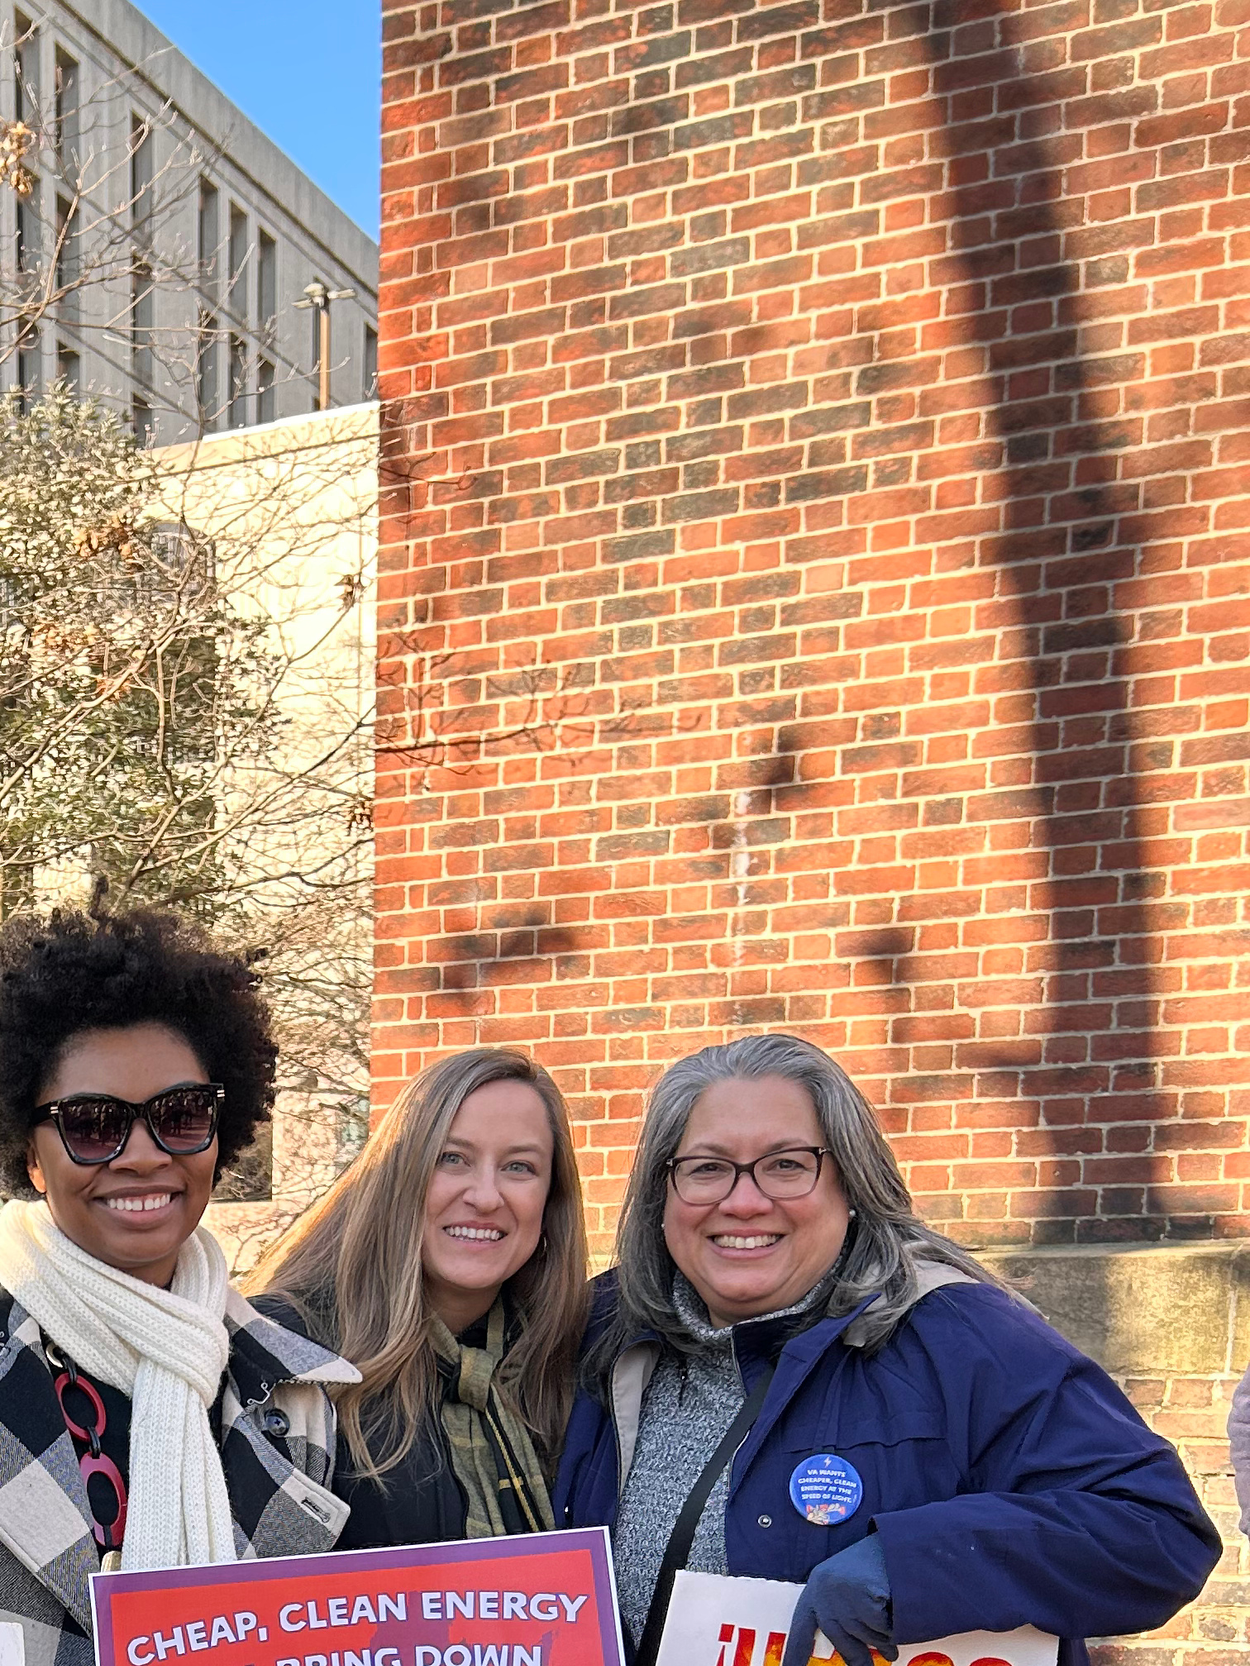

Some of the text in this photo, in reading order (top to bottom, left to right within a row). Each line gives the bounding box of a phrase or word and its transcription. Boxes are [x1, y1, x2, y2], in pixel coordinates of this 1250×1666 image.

[819, 1469, 846, 1478] WANTS
[834, 1478, 857, 1488] CLEAN
[838, 1487, 852, 1495] THE
[127, 1591, 588, 1666] CHEAP, CLEAN ENERGY
